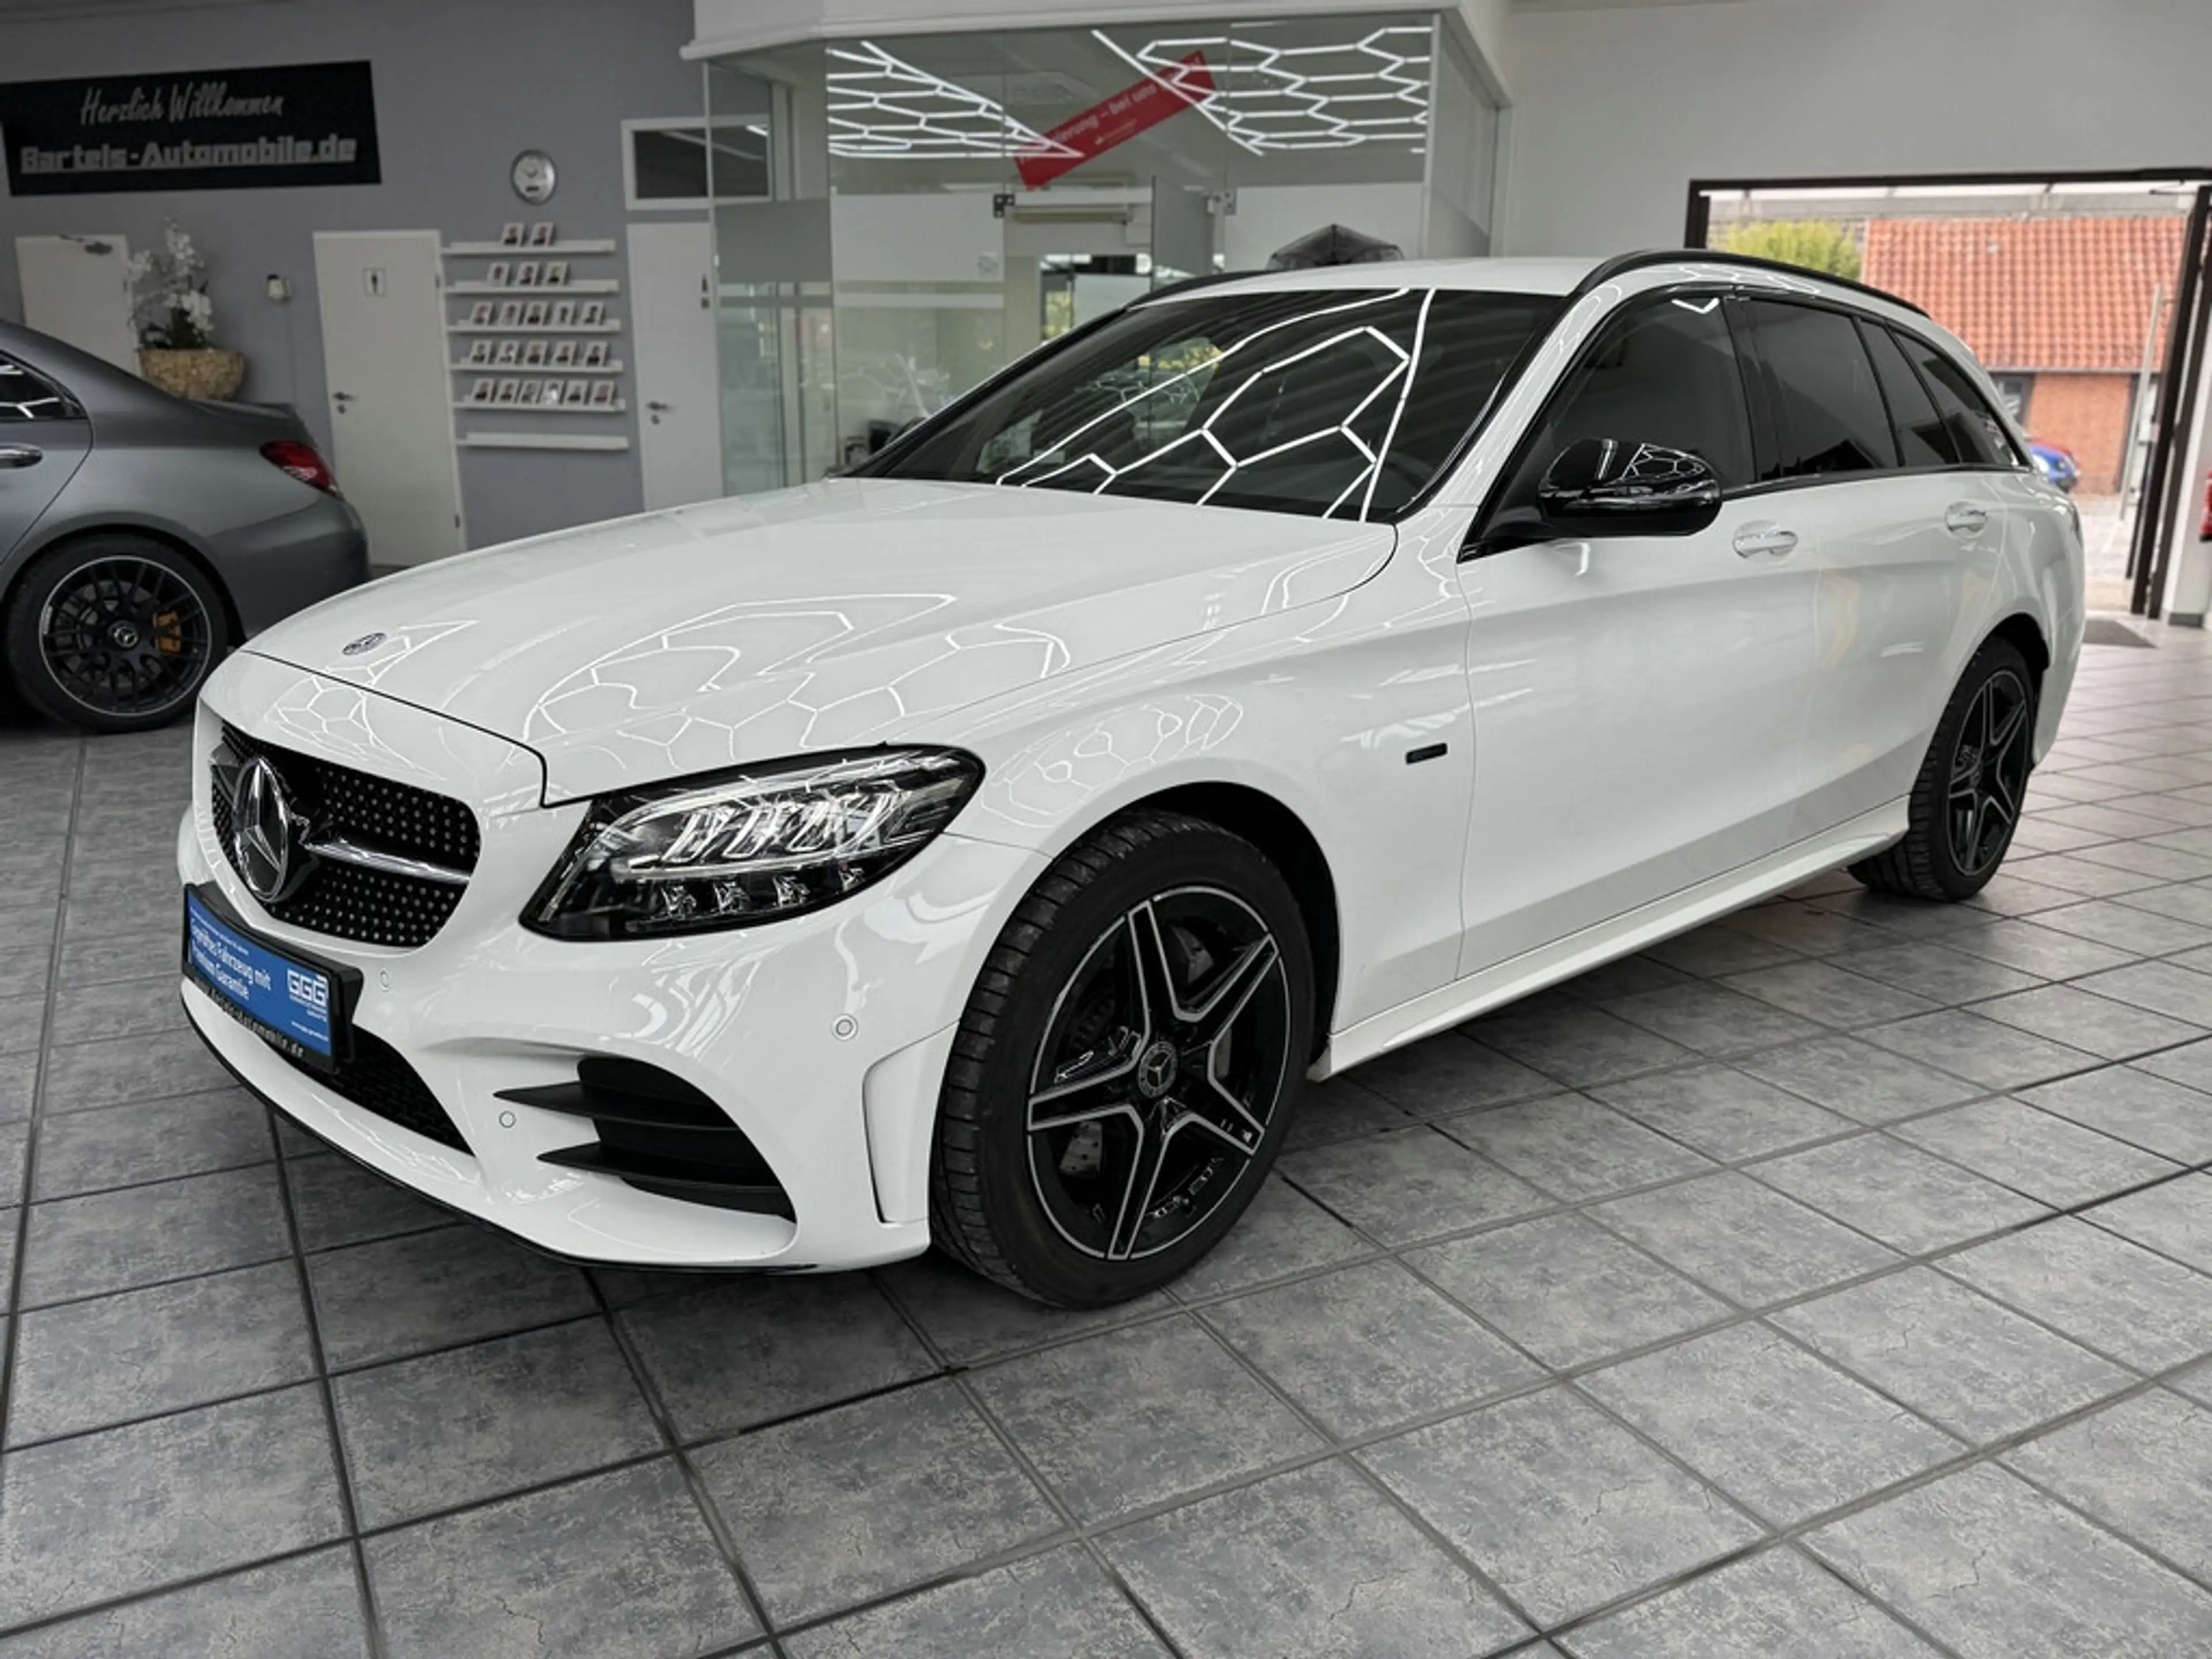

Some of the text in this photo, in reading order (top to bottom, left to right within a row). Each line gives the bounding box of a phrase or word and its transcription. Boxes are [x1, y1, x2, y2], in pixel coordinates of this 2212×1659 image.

[79, 81, 285, 125] Herzlich Willkommen
[20, 133, 357, 173] Bartels-Automobile.de
